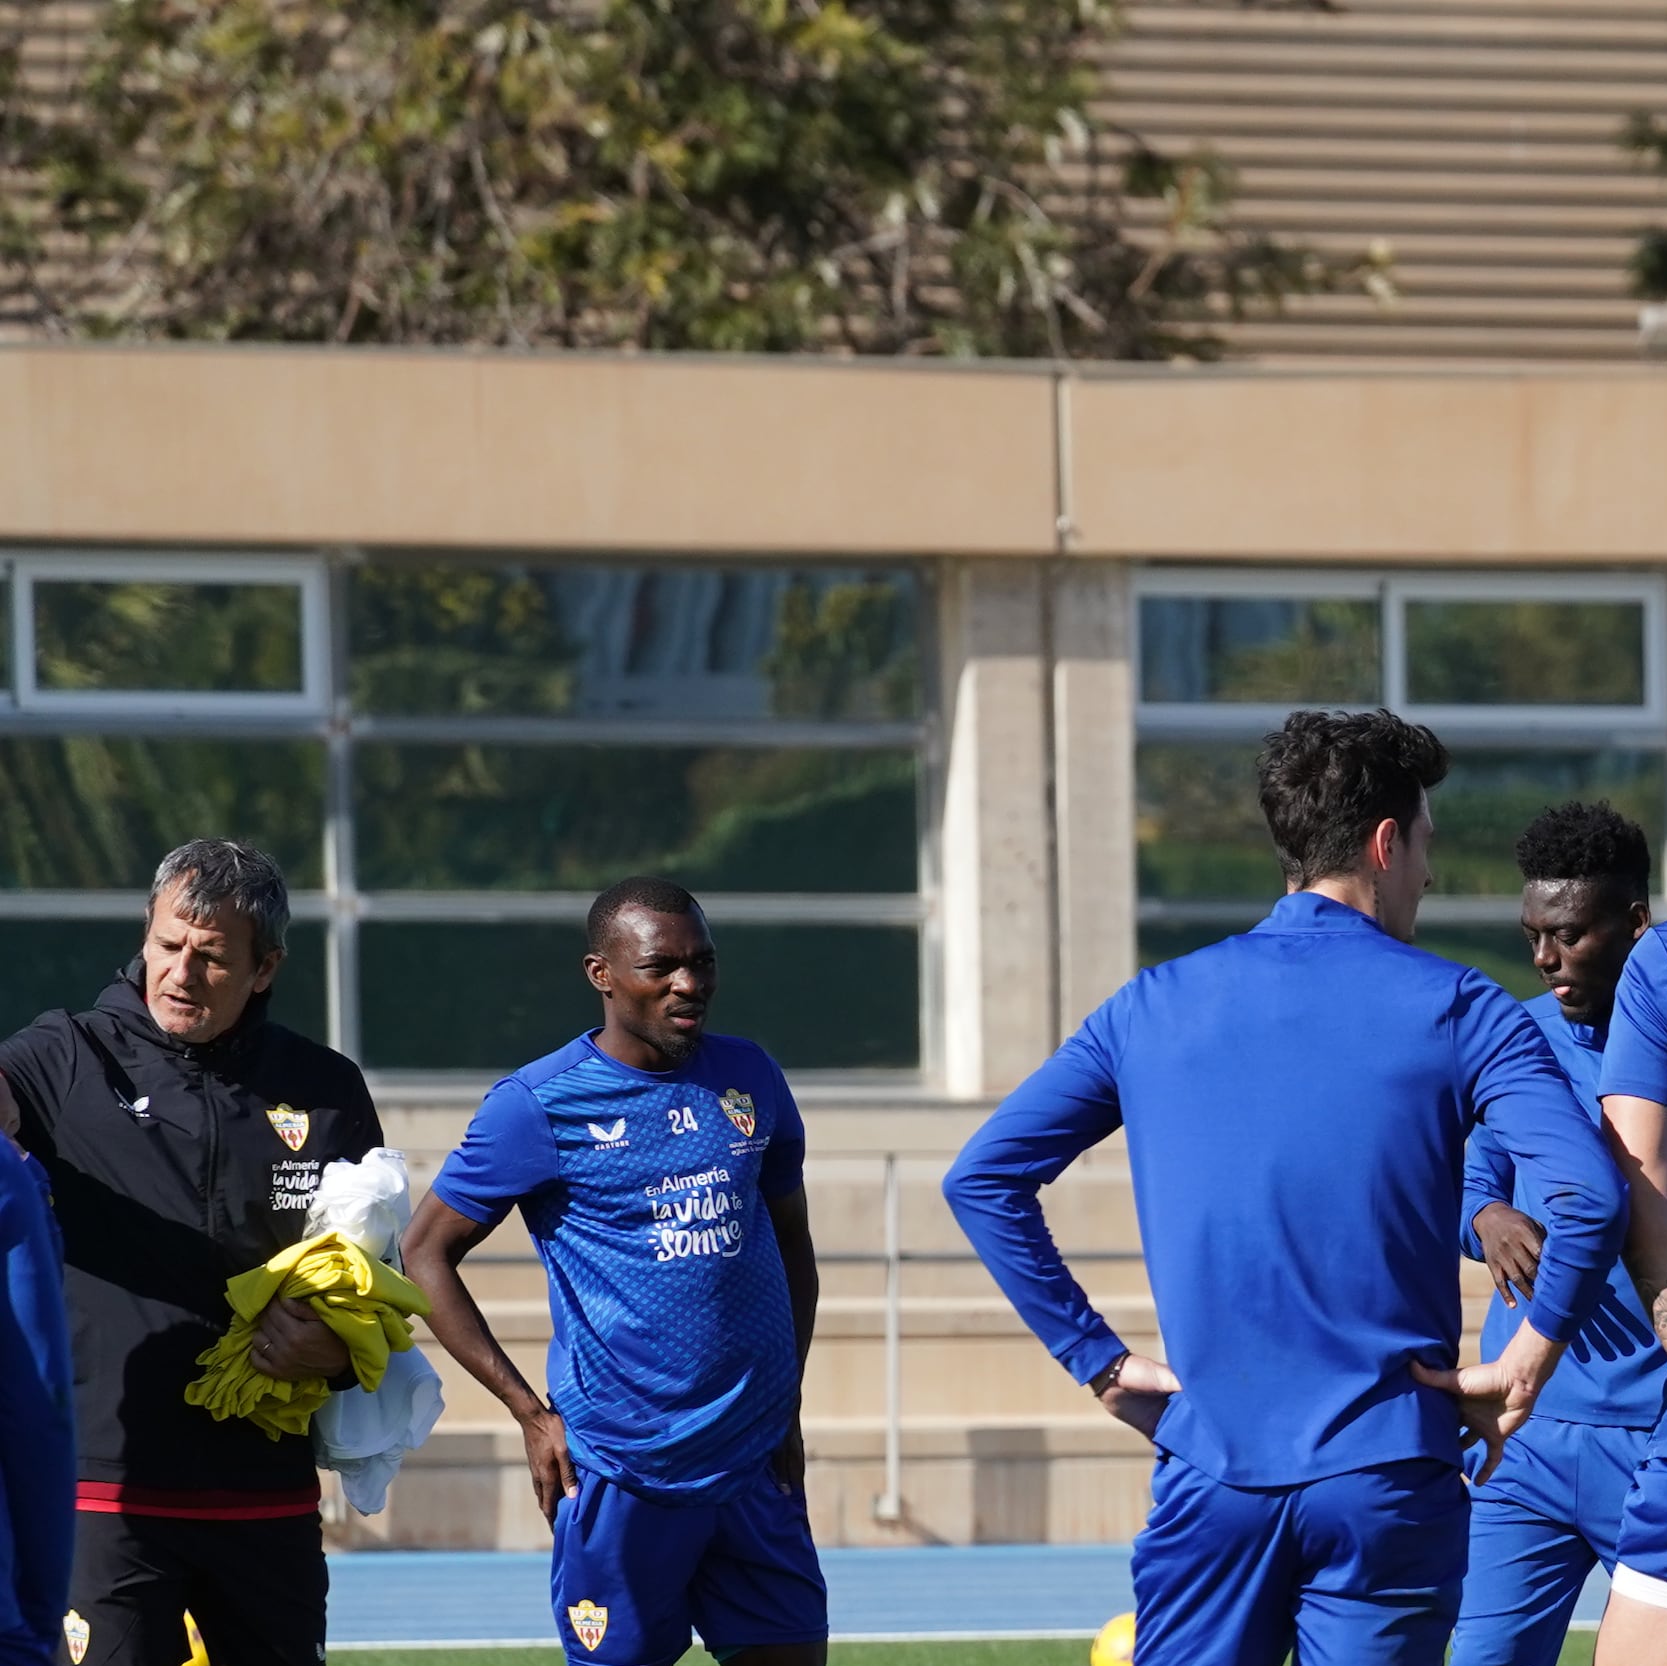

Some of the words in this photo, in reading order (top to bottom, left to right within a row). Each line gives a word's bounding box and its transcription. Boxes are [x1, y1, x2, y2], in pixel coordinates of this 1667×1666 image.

[667, 1106, 699, 1135] 24
[594, 1140, 630, 1151] CASTORE
[272, 1172, 285, 1186] la
[645, 1185, 661, 1198] En
[661, 1165, 731, 1194] Almería
[651, 1199, 673, 1220] la
[673, 1186, 731, 1223] vida
[729, 1191, 744, 1210] te
